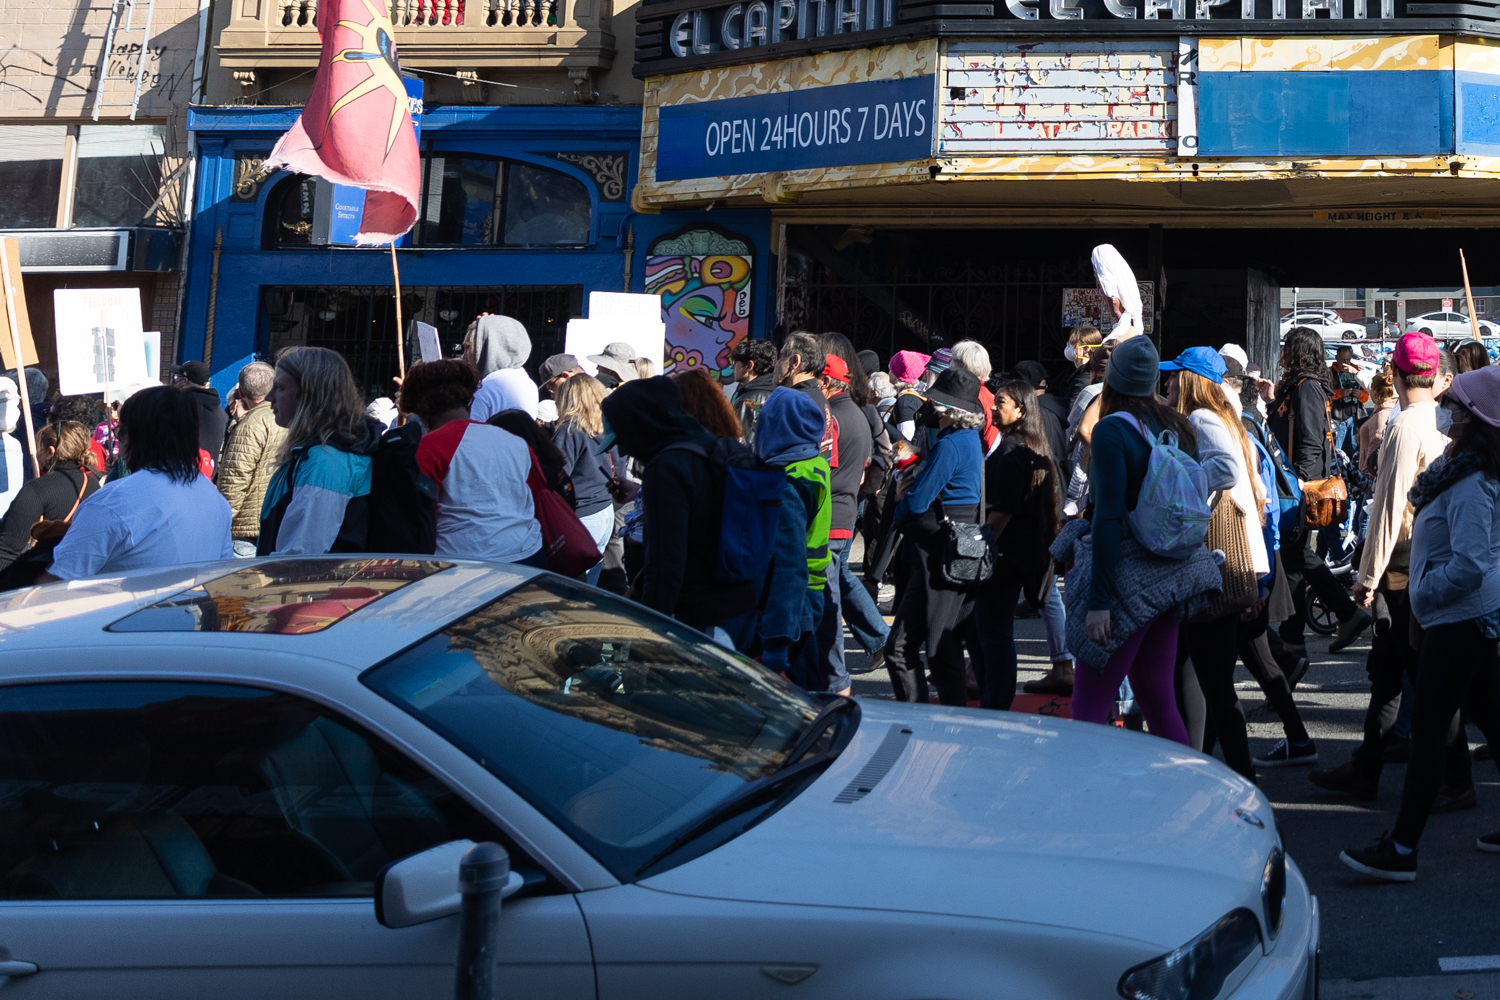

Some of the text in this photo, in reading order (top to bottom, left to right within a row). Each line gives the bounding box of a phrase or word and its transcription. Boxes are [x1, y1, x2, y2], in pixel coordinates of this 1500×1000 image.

[670, 11, 711, 58] EL
[706, 99, 927, 157] OPEN 24HOURS 7 DAYS
[1327, 212, 1353, 220] MAX
[1357, 212, 1397, 221] HEIGHT
